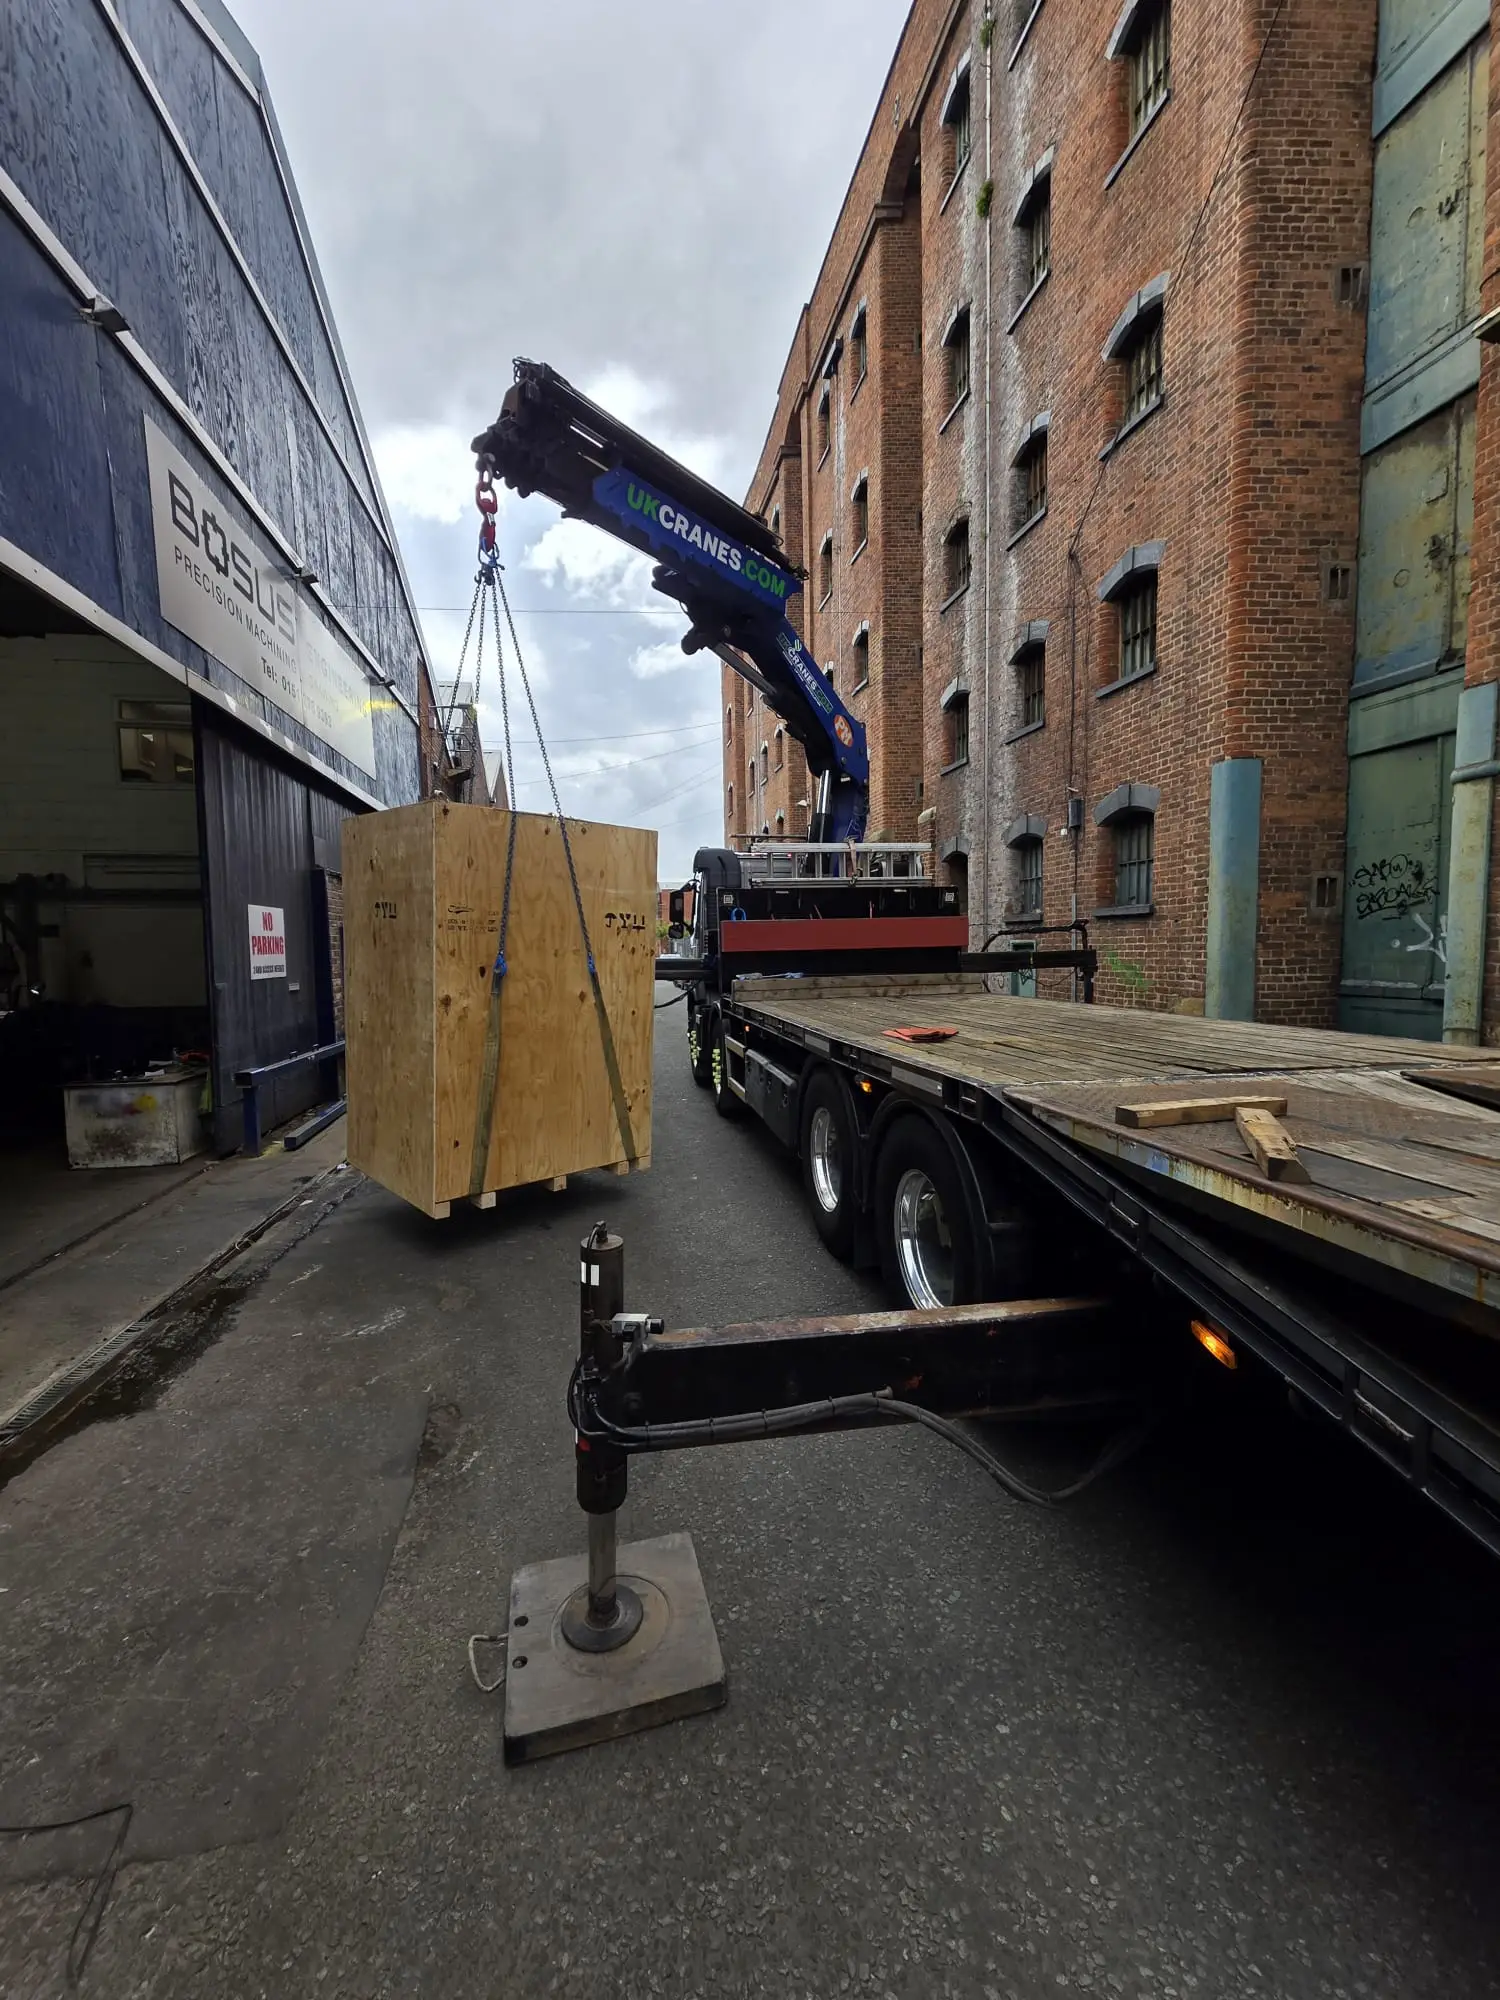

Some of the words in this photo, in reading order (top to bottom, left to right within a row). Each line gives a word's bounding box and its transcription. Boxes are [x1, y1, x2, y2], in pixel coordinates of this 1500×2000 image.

[627, 482, 785, 597] UKCRANES.COM
[174, 544, 243, 626] PRECISION
[245, 615, 298, 674] MACHINING
[261, 656, 278, 684] Tel:
[262, 911, 273, 931] NO
[251, 935, 284, 956] PARKING
